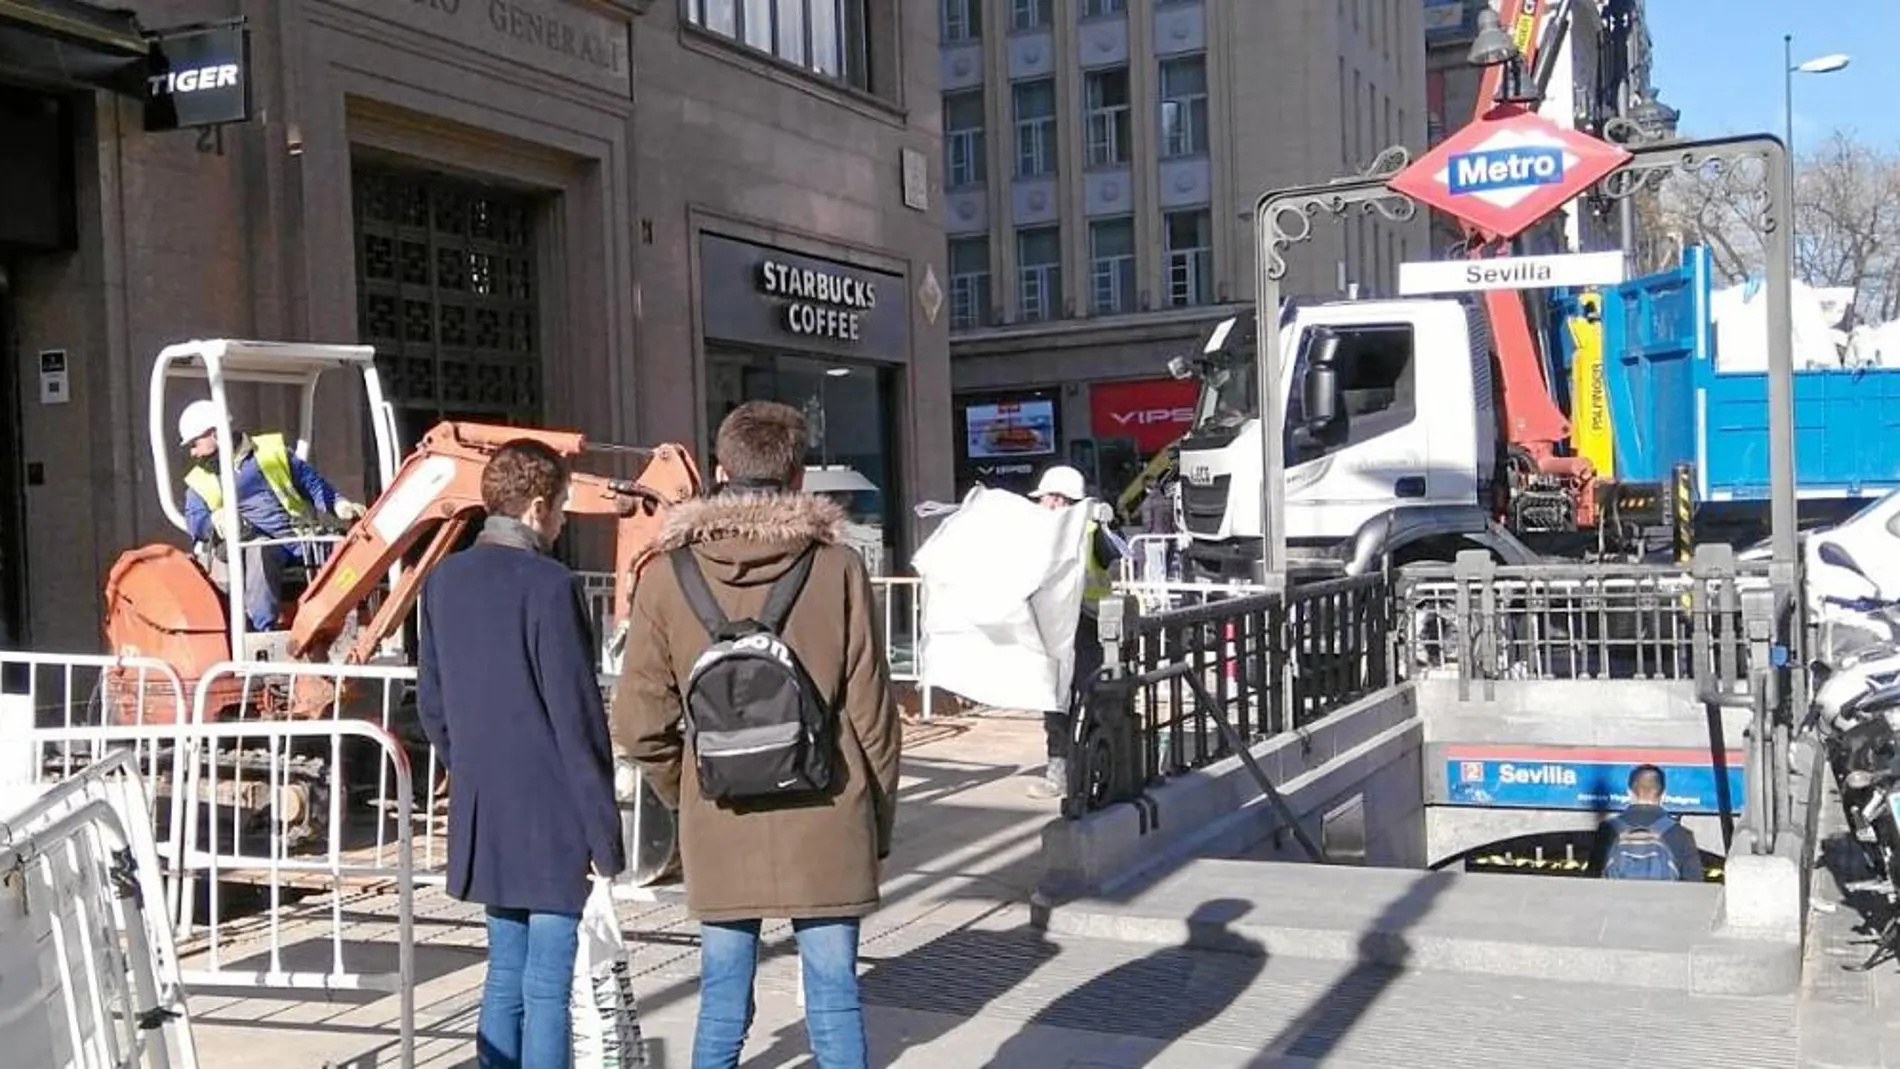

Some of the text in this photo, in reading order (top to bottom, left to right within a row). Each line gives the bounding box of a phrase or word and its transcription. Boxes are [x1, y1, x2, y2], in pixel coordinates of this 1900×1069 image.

[147, 64, 238, 97] TIGER
[1457, 153, 1557, 187] Metro
[763, 260, 877, 308] STARBUCKS
[1465, 263, 1551, 284] Sevilla
[788, 303, 860, 340] COFFEE
[1108, 406, 1195, 425] VIPS
[1499, 763, 1578, 785] Sevilla
